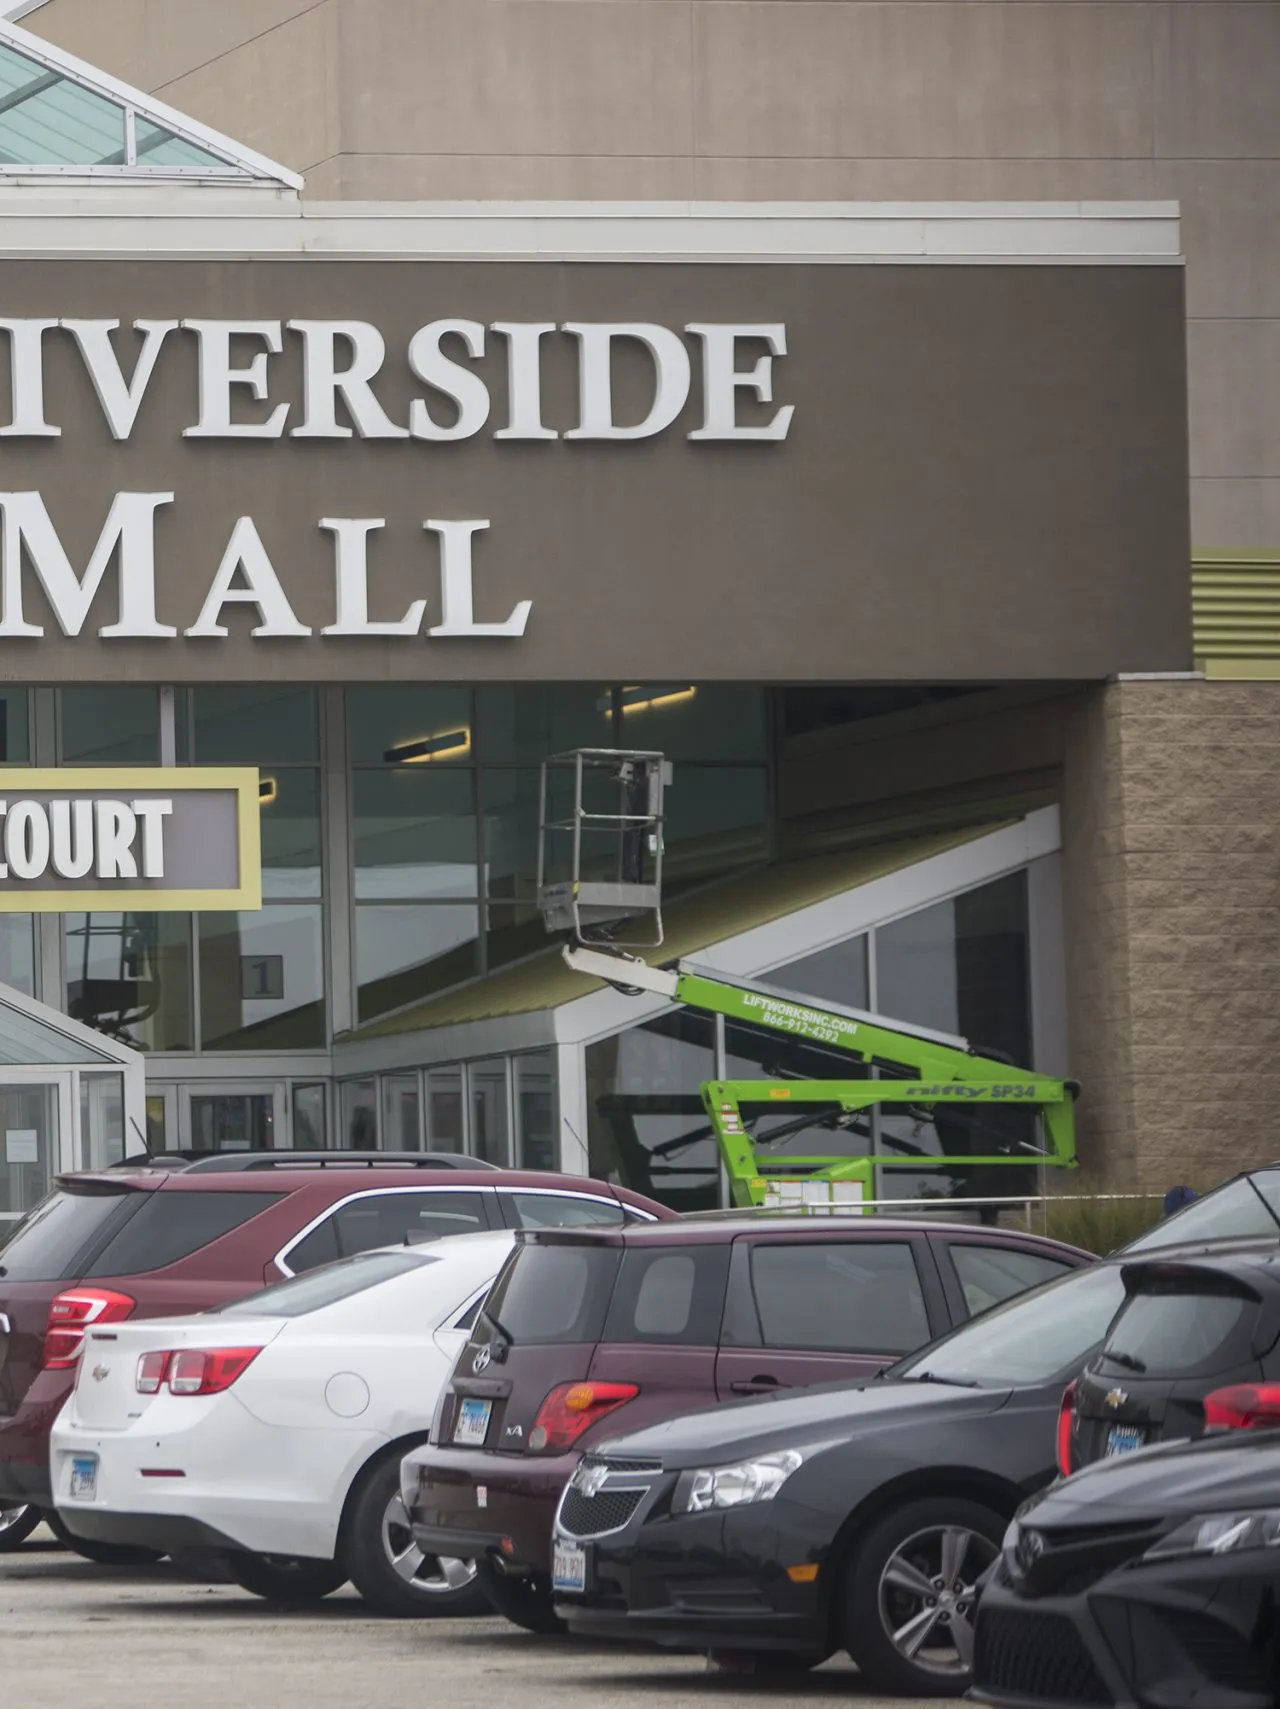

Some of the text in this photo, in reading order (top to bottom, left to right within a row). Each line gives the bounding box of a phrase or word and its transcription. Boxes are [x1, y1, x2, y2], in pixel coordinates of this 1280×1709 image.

[743, 993, 858, 1035] LIFTWORKSINC.COM
[763, 1011, 839, 1043] 866-912-4292
[990, 1084, 1036, 1098] SP34
